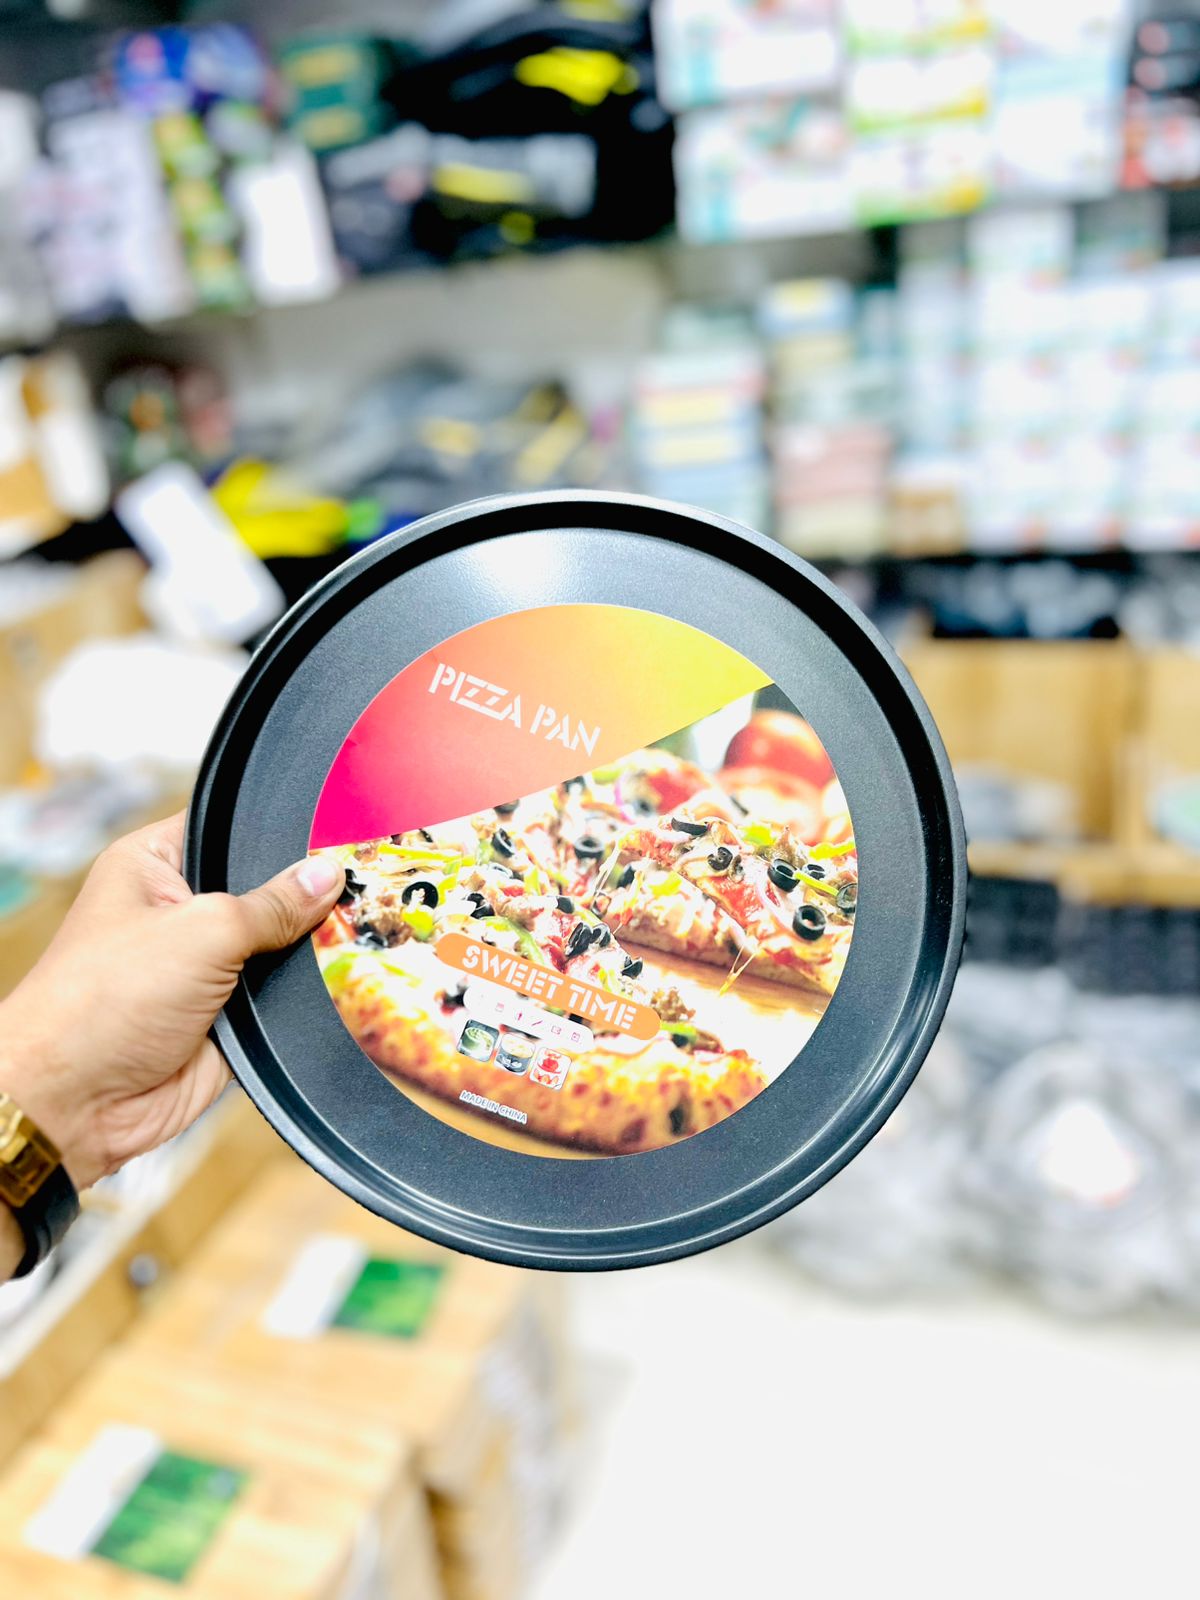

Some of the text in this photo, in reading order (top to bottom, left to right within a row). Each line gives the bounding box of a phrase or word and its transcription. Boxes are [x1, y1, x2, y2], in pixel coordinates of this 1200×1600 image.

[428, 663, 601, 757] PIZZA PAN
[462, 945, 637, 1030] SWEET TIME
[460, 1090, 527, 1122] MADE IN CHINA
